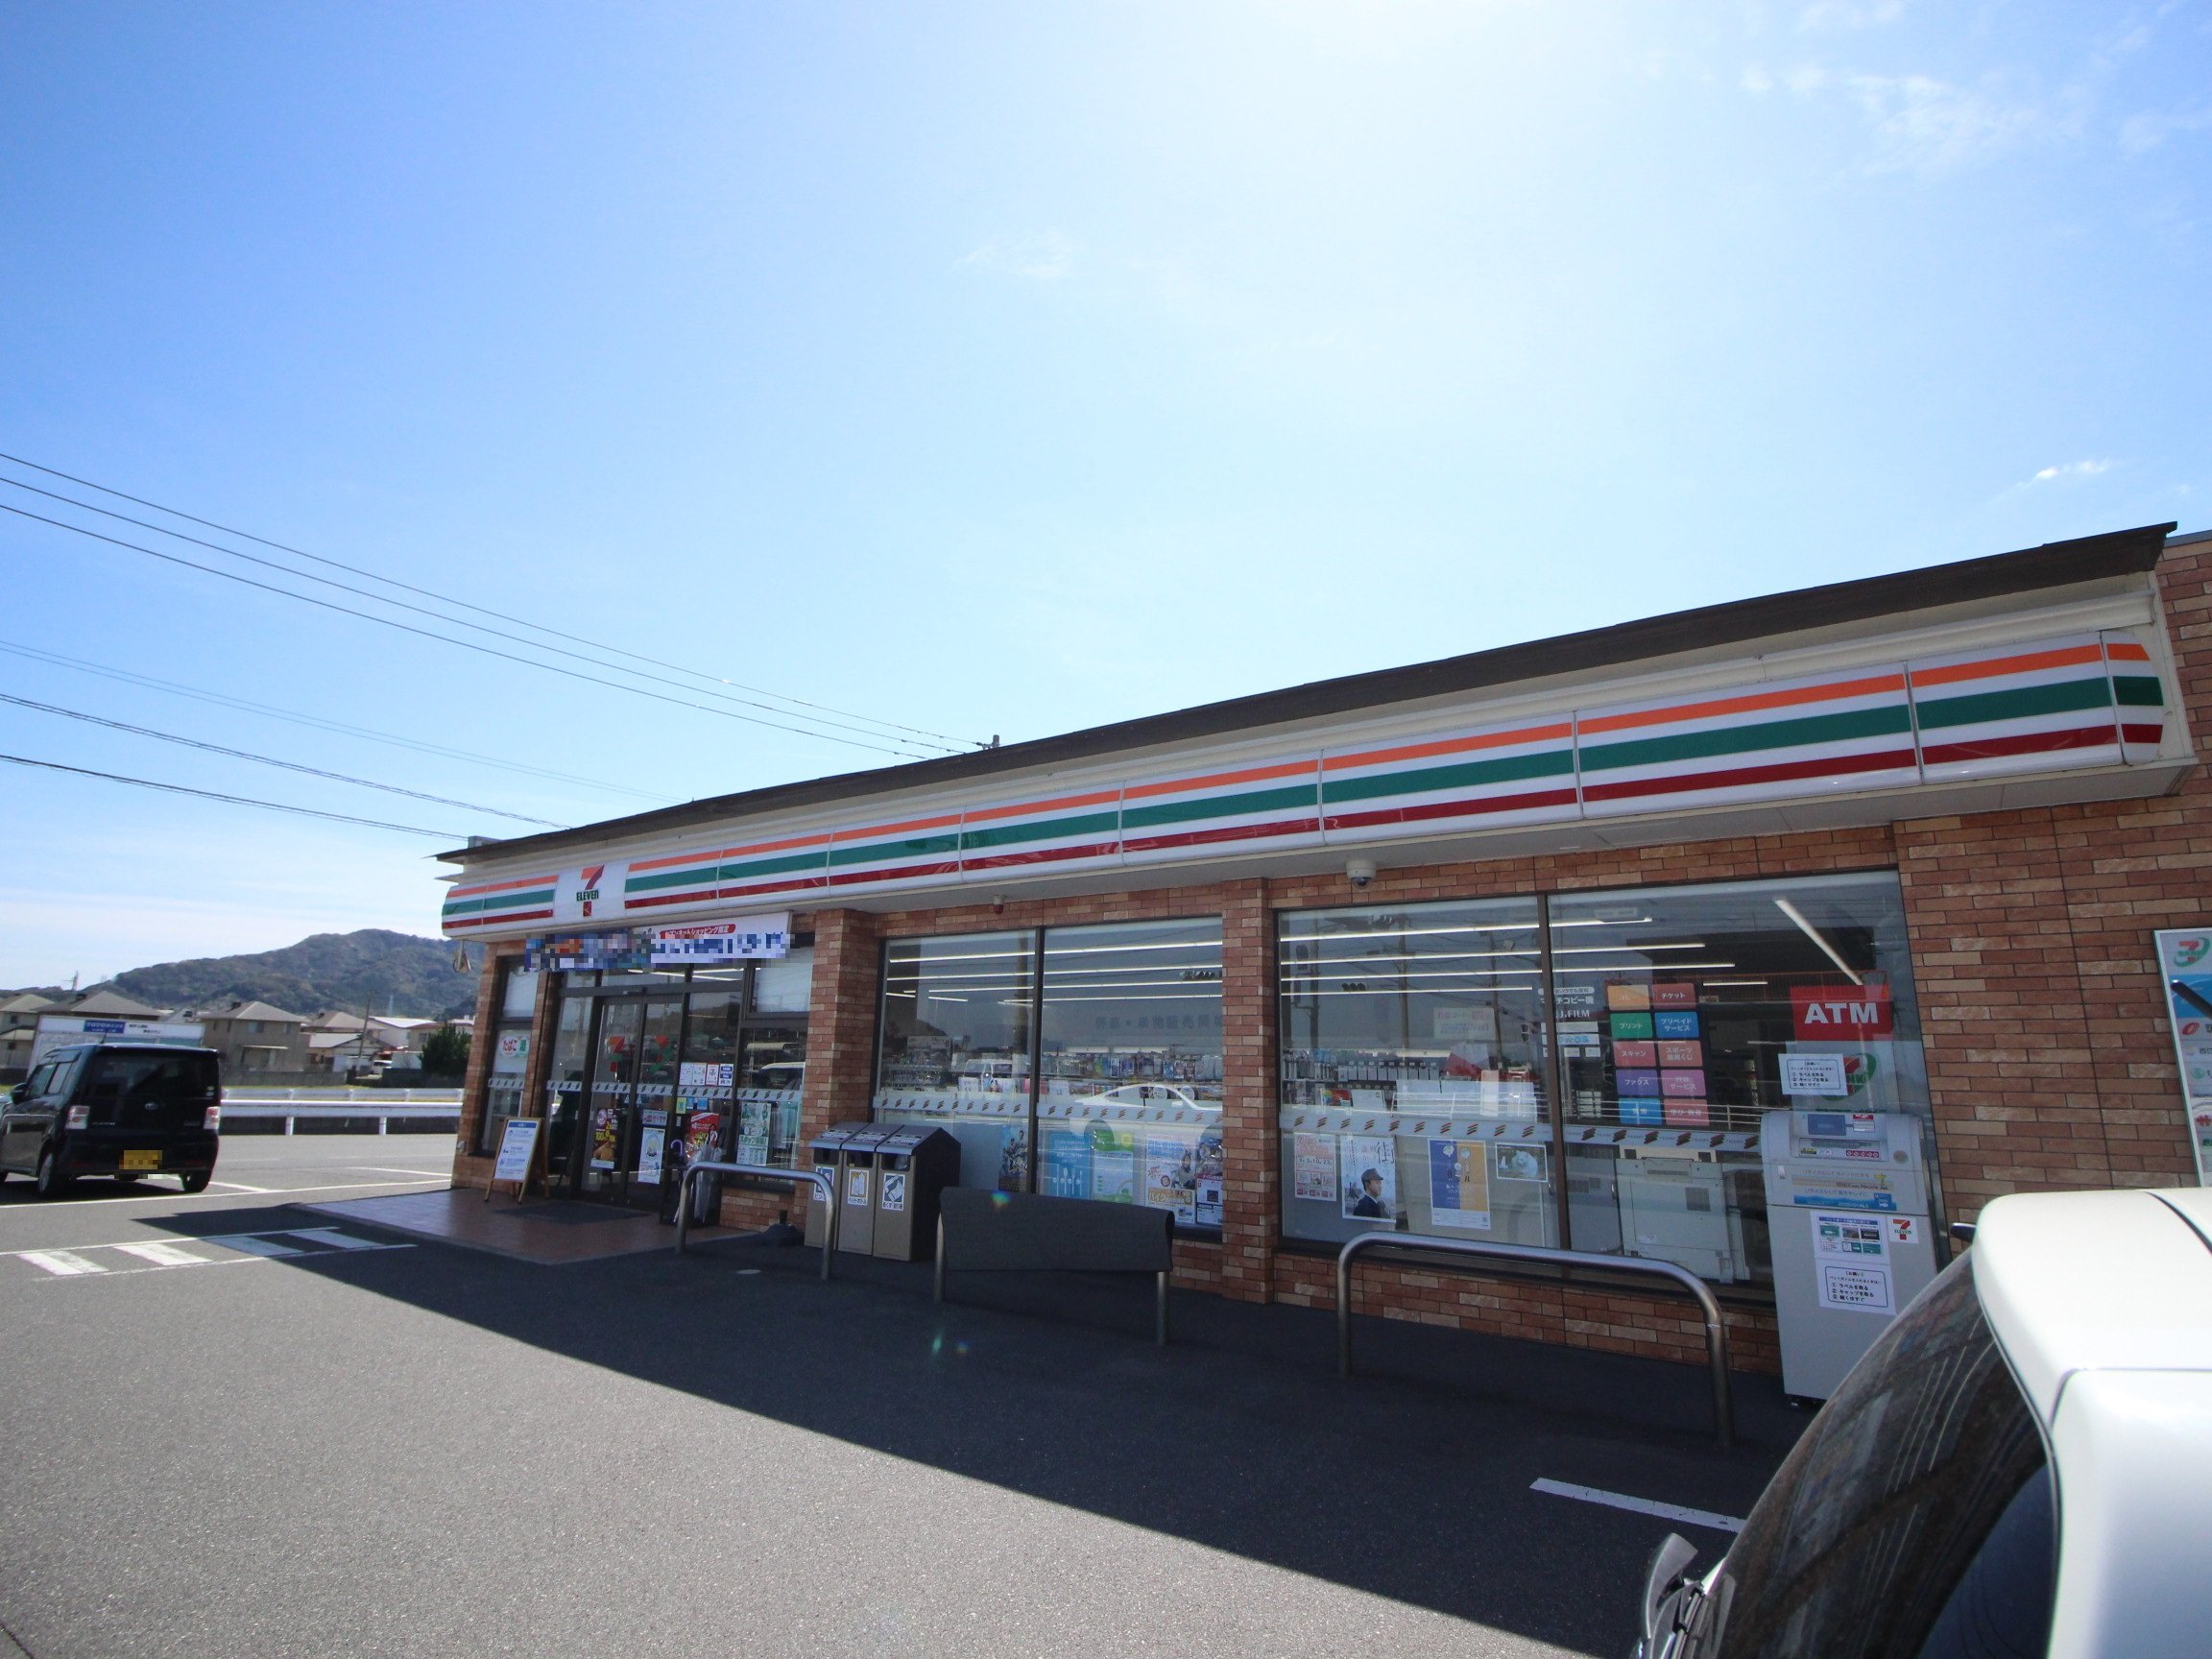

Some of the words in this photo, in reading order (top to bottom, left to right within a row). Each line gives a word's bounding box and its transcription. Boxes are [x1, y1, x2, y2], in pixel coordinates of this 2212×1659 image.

[1541, 996, 1594, 1004] チコピー機
[1805, 1002, 1878, 1024] ATM
[1670, 1082, 1697, 1091] サービス
[1839, 1289, 1874, 1298] キャップを取る
